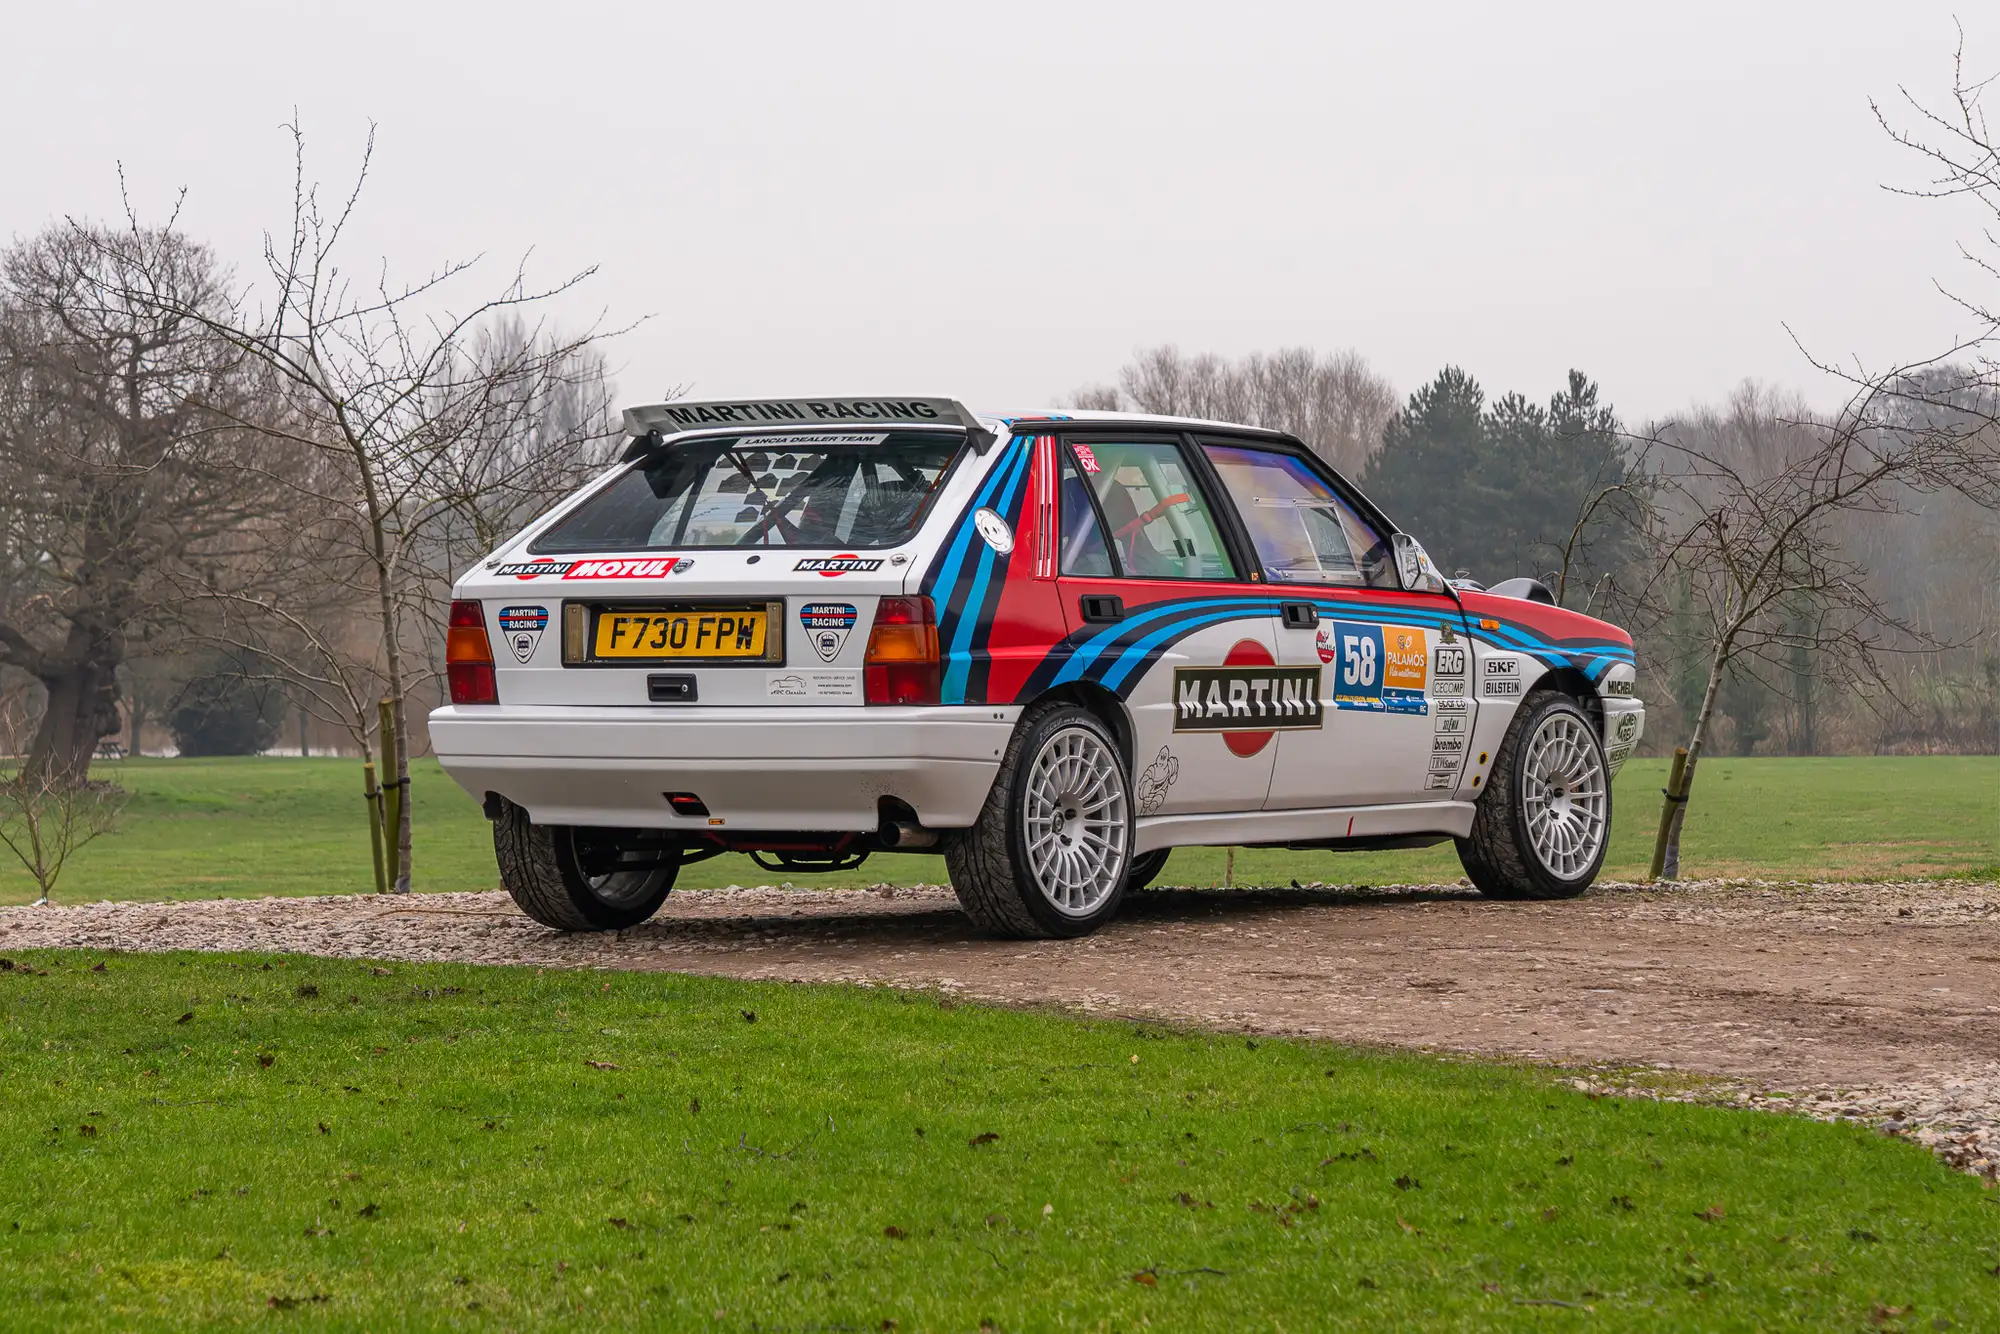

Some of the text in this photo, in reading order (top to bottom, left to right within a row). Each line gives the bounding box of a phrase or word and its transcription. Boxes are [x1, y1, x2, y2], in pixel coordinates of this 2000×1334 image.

[664, 401, 938, 425] MARTINI RACING
[745, 435, 876, 445] LANCIA DEALER TEAM
[1081, 458, 1100, 470] OK
[498, 563, 571, 575] MARTINI
[568, 560, 669, 577] MOTUL
[798, 560, 880, 571] MARTINI
[509, 608, 538, 617] MARTINI
[812, 606, 845, 614] MARTINI
[509, 620, 538, 629] RACING
[812, 618, 845, 627] RACING
[610, 617, 756, 649] F730 FPW
[1343, 635, 1376, 687] 58
[1387, 651, 1425, 667] PALAMÓS
[1437, 650, 1463, 674] ERG
[1487, 661, 1516, 673] SKF
[1434, 682, 1464, 693] CECOMP
[1485, 682, 1520, 694] BILSTEIN
[1179, 678, 1317, 719] MARTINI
[1434, 738, 1461, 751] brembo
